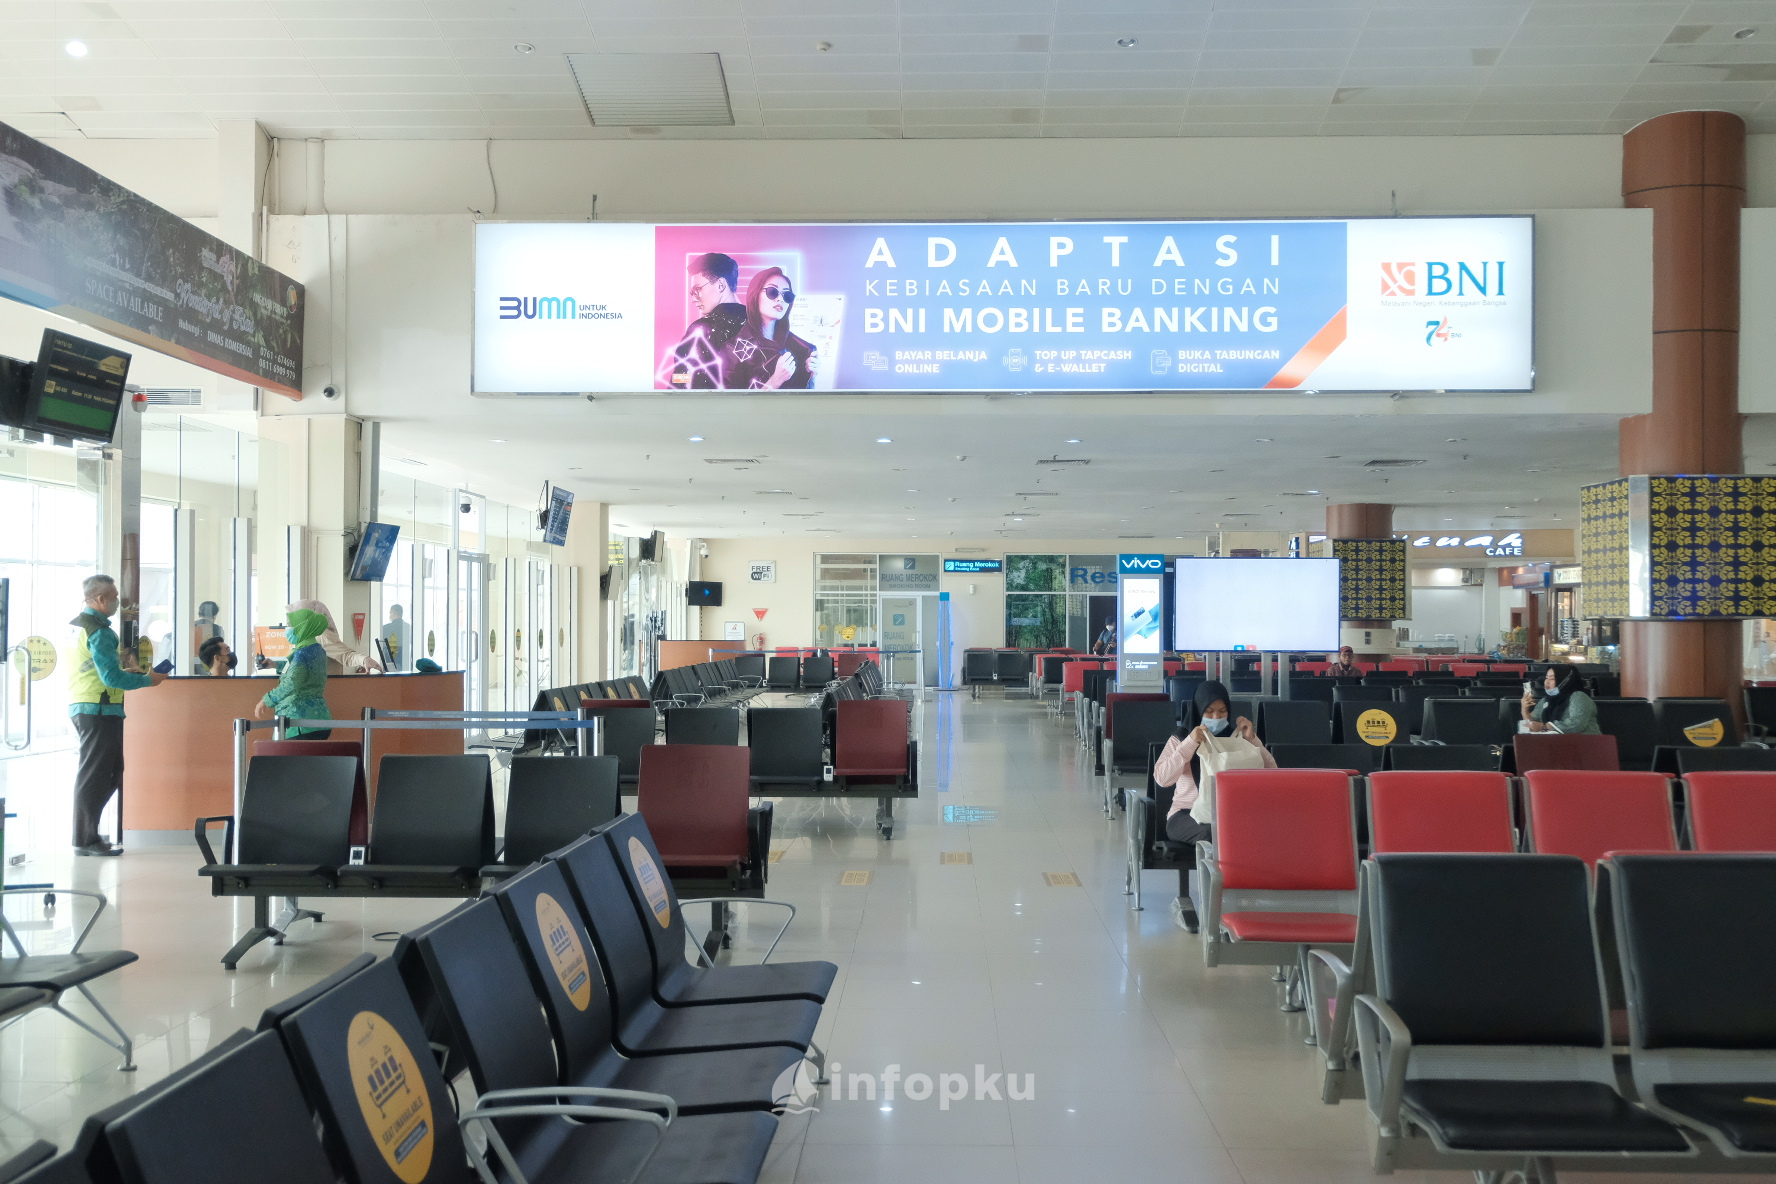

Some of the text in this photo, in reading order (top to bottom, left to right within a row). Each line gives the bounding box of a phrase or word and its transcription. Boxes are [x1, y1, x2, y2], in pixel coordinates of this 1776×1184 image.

[865, 235, 1280, 268] ADAPTASI
[1425, 261, 1507, 297] BNI
[866, 277, 1280, 296] KEBIASAAN BARU DENGAN
[85, 277, 164, 322] SPACE AVAILABLE
[579, 312, 623, 320] INDONESIA
[864, 306, 1279, 333] BNI MOBILE BANKING
[207, 330, 253, 359] DINAS KOMERSIAL
[259, 347, 273, 360] 0761
[895, 350, 987, 361] BAYAR BELANJA
[1034, 350, 1132, 360] TOP UP TAPCASH
[1178, 350, 1280, 360] BUKA TABUNGAN
[258, 358, 272, 371] 0811
[895, 363, 940, 373] ONLINE
[1034, 363, 1106, 373] & E-WALLET
[1178, 363, 1224, 373] DIGITAL
[1485, 547, 1522, 556] CAFE
[1121, 557, 1162, 568] vivo
[881, 573, 938, 582] RUANG MEROKOK
[884, 632, 905, 640] RUANG
